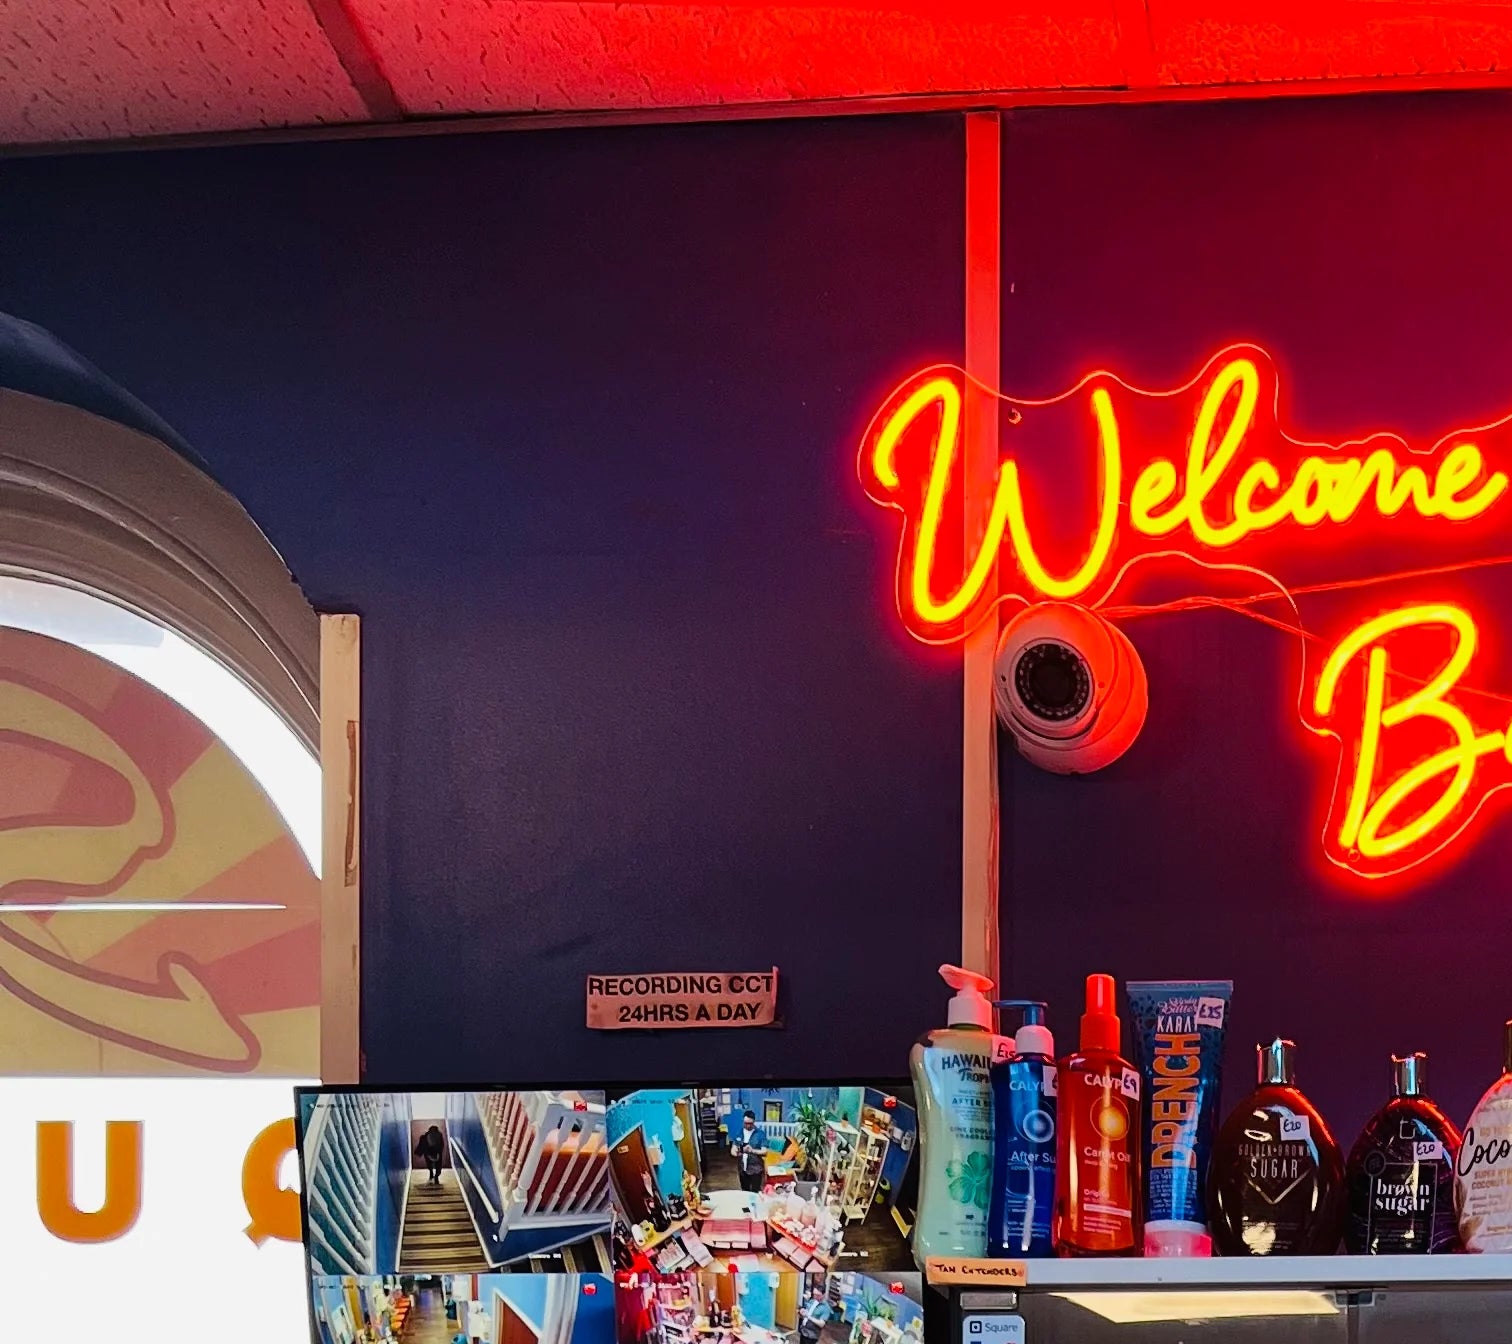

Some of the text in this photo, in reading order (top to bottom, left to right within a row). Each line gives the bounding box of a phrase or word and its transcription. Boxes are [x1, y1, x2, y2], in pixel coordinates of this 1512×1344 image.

[875, 357, 1510, 623] Welcome
[588, 975, 722, 996] RECORDING
[619, 1003, 761, 1023] 24HRS A DAY
[1152, 1034, 1201, 1169] DRENCH
[1011, 1151, 1039, 1162] After
[1251, 1158, 1299, 1179] SUGAR
[1376, 1178, 1430, 1196] brown
[1375, 1196, 1430, 1215] sugar
[936, 1265, 956, 1274] TAN
[985, 1322, 1018, 1334] Square
